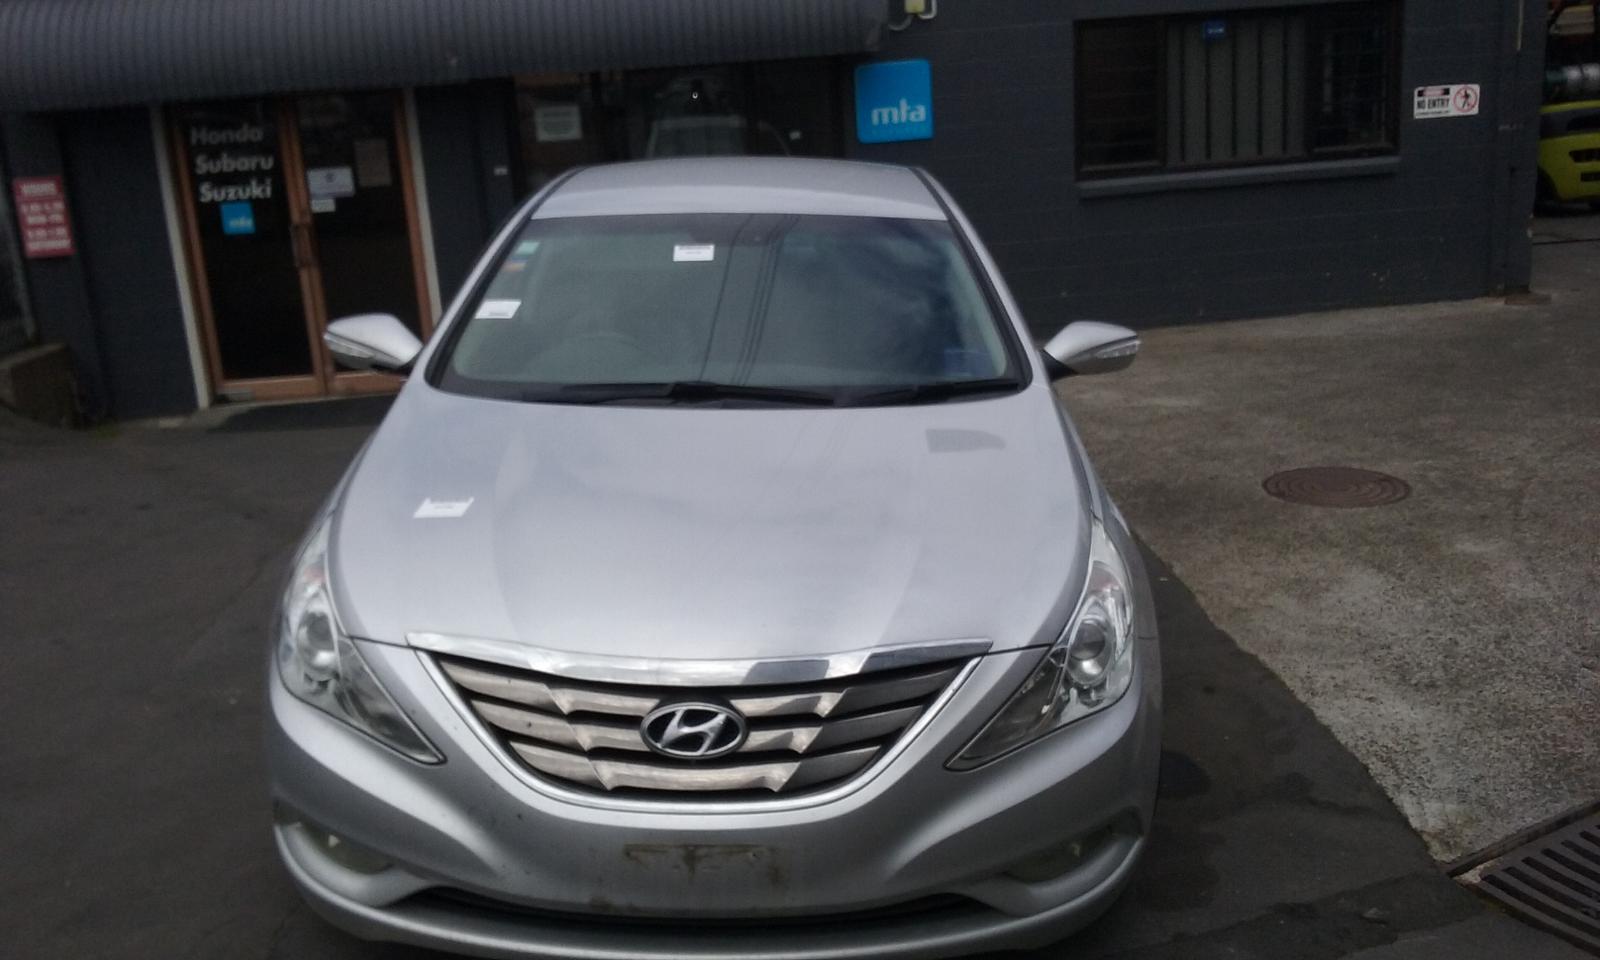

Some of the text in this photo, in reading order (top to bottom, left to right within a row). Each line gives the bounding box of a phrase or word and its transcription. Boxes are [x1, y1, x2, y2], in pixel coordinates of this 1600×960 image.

[871, 98, 926, 126] mta
[1427, 98, 1449, 109] ENTRY
[191, 124, 263, 145] Honda
[195, 153, 273, 174] Subaru
[199, 178, 271, 202] Suzuki
